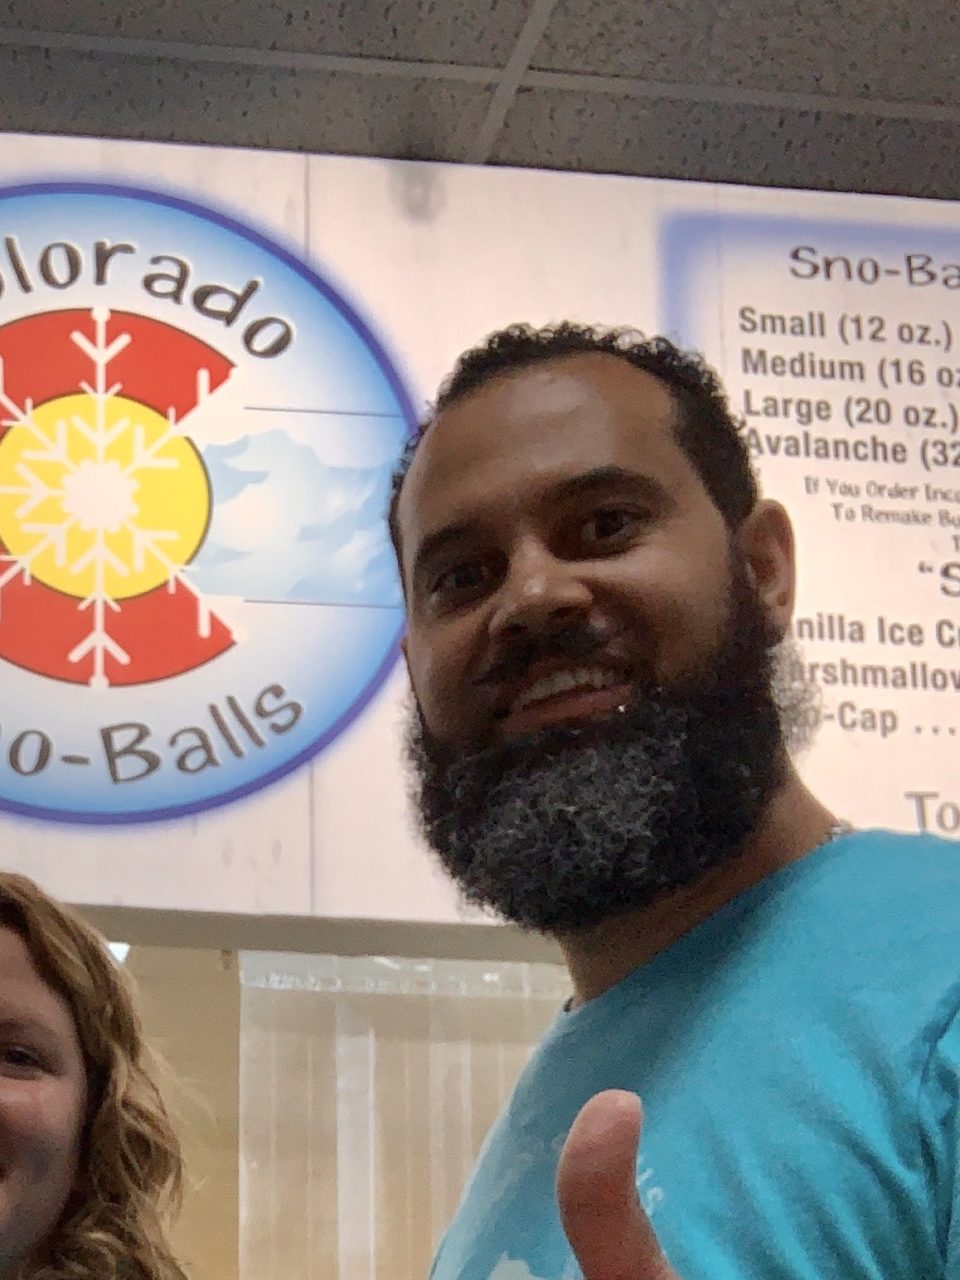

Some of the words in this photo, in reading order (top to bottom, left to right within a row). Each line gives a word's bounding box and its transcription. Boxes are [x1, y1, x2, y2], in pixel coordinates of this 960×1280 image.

[740, 306, 826, 338] Small
[839, 313, 886, 346] (12
[897, 320, 952, 353] oz.)
[742, 348, 866, 383] Medium
[878, 357, 925, 389] (16
[937, 366, 960, 389] o
[743, 389, 833, 426] Large
[844, 396, 891, 429] (20
[904, 402, 958, 435] oz.)
[746, 429, 907, 465] Avalanche
[826, 477, 861, 498] You
[866, 480, 919, 500] Order
[861, 504, 932, 526] Remake
[877, 615, 925, 647] Ice
